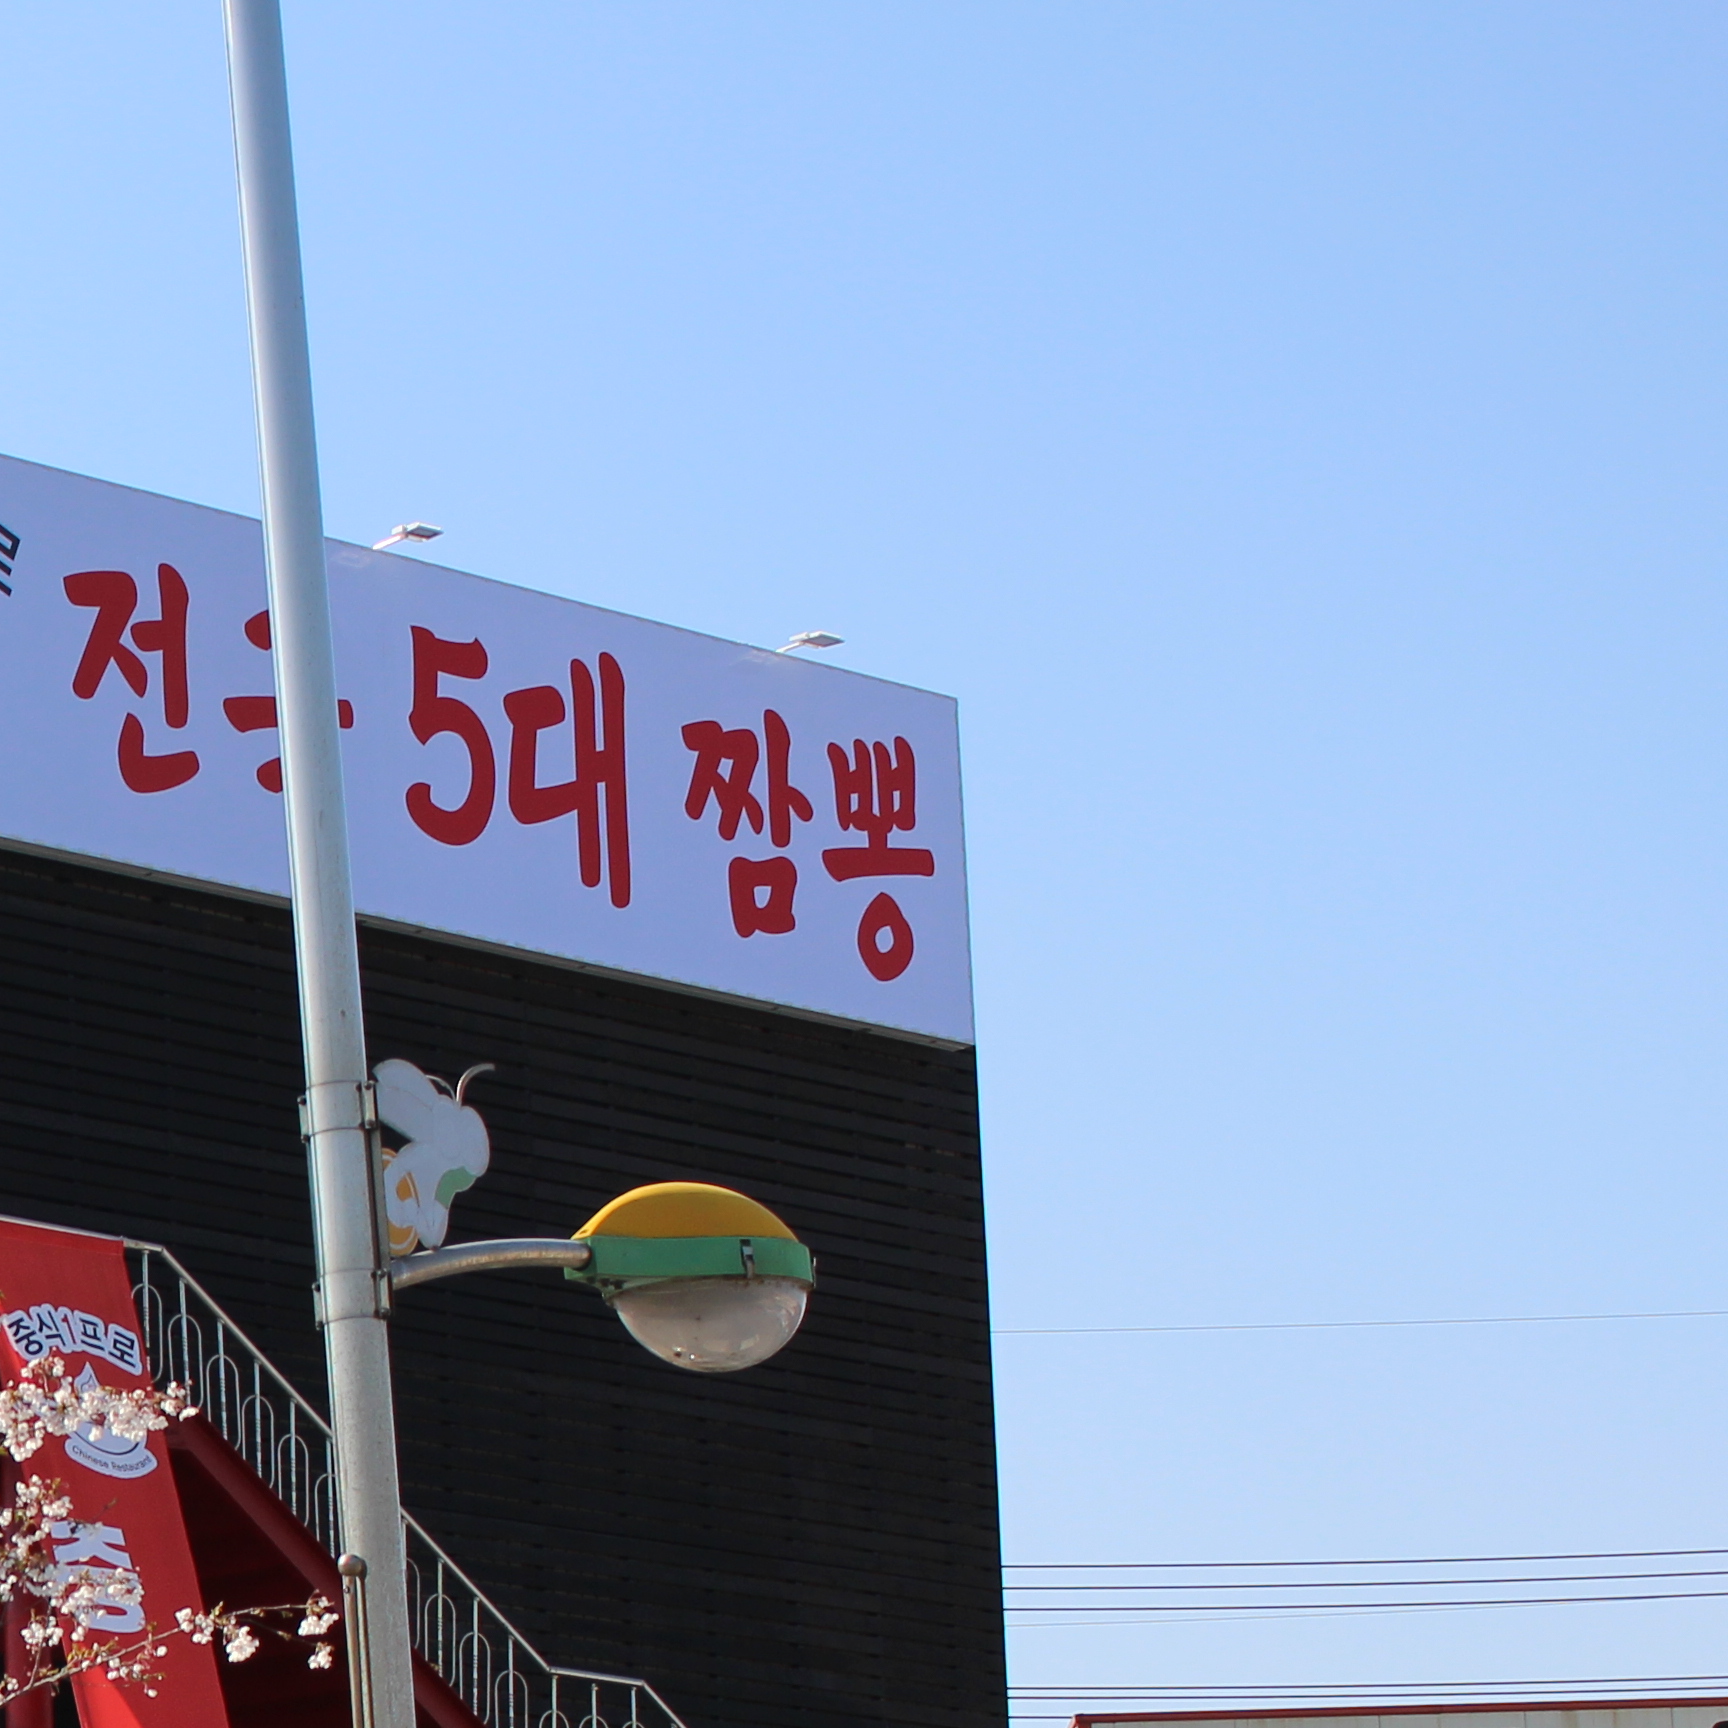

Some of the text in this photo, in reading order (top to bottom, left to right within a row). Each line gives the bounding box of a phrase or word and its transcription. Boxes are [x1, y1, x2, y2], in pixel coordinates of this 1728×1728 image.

[406, 626, 631, 909] 5대
[681, 709, 935, 982] 짬뽕
[8, 1310, 138, 1370] 중식1프로
[72, 1444, 153, 1473] Chinese Restaurant
